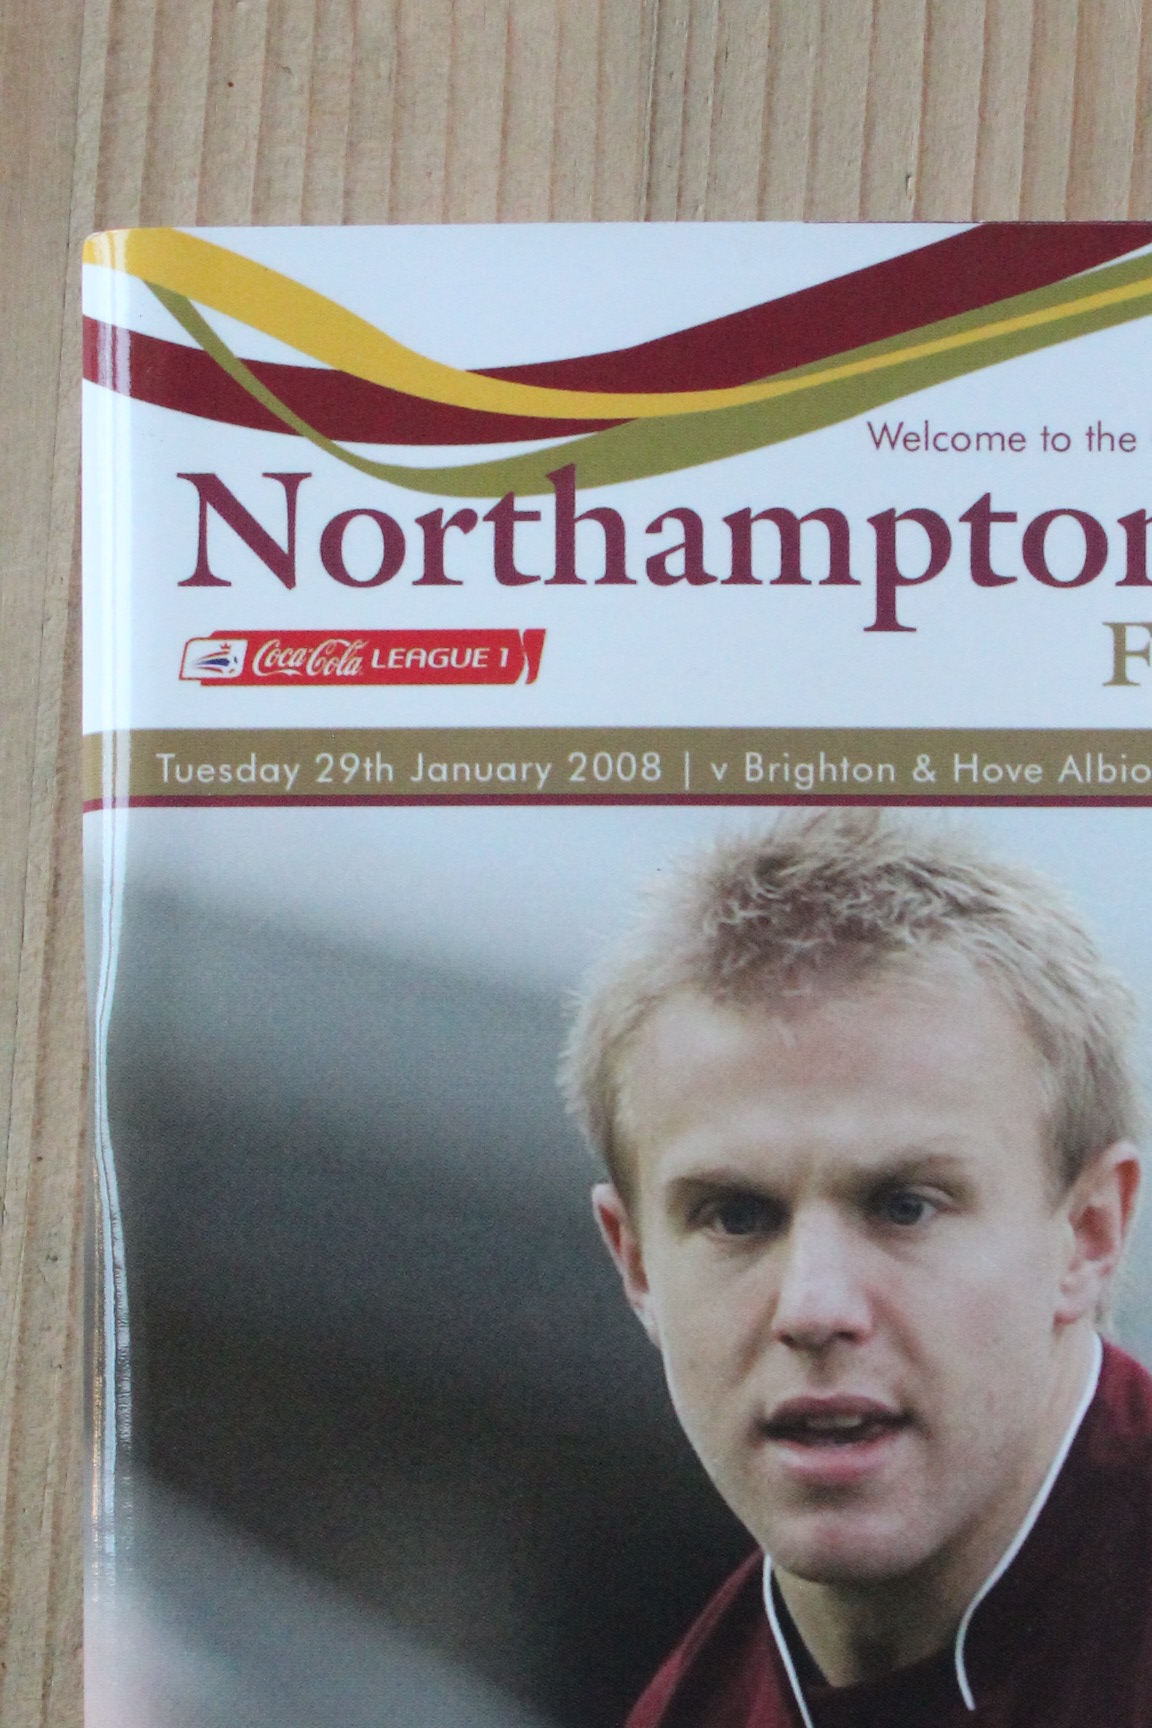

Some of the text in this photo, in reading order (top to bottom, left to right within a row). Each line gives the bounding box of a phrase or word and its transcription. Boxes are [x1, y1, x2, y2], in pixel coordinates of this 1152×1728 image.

[867, 420, 1026, 452] Welcome
[1041, 426, 1071, 452] to
[1086, 421, 1136, 453] the
[371, 648, 490, 669] LEAGUE
[499, 648, 508, 668] 1
[156, 753, 299, 790] Tuesday
[316, 752, 393, 783] 29th
[411, 753, 551, 789] January
[569, 752, 661, 781] 2008
[711, 763, 727, 780] v
[745, 752, 894, 790] Brighton
[913, 754, 935, 782] &
[954, 754, 1042, 783] Hove
